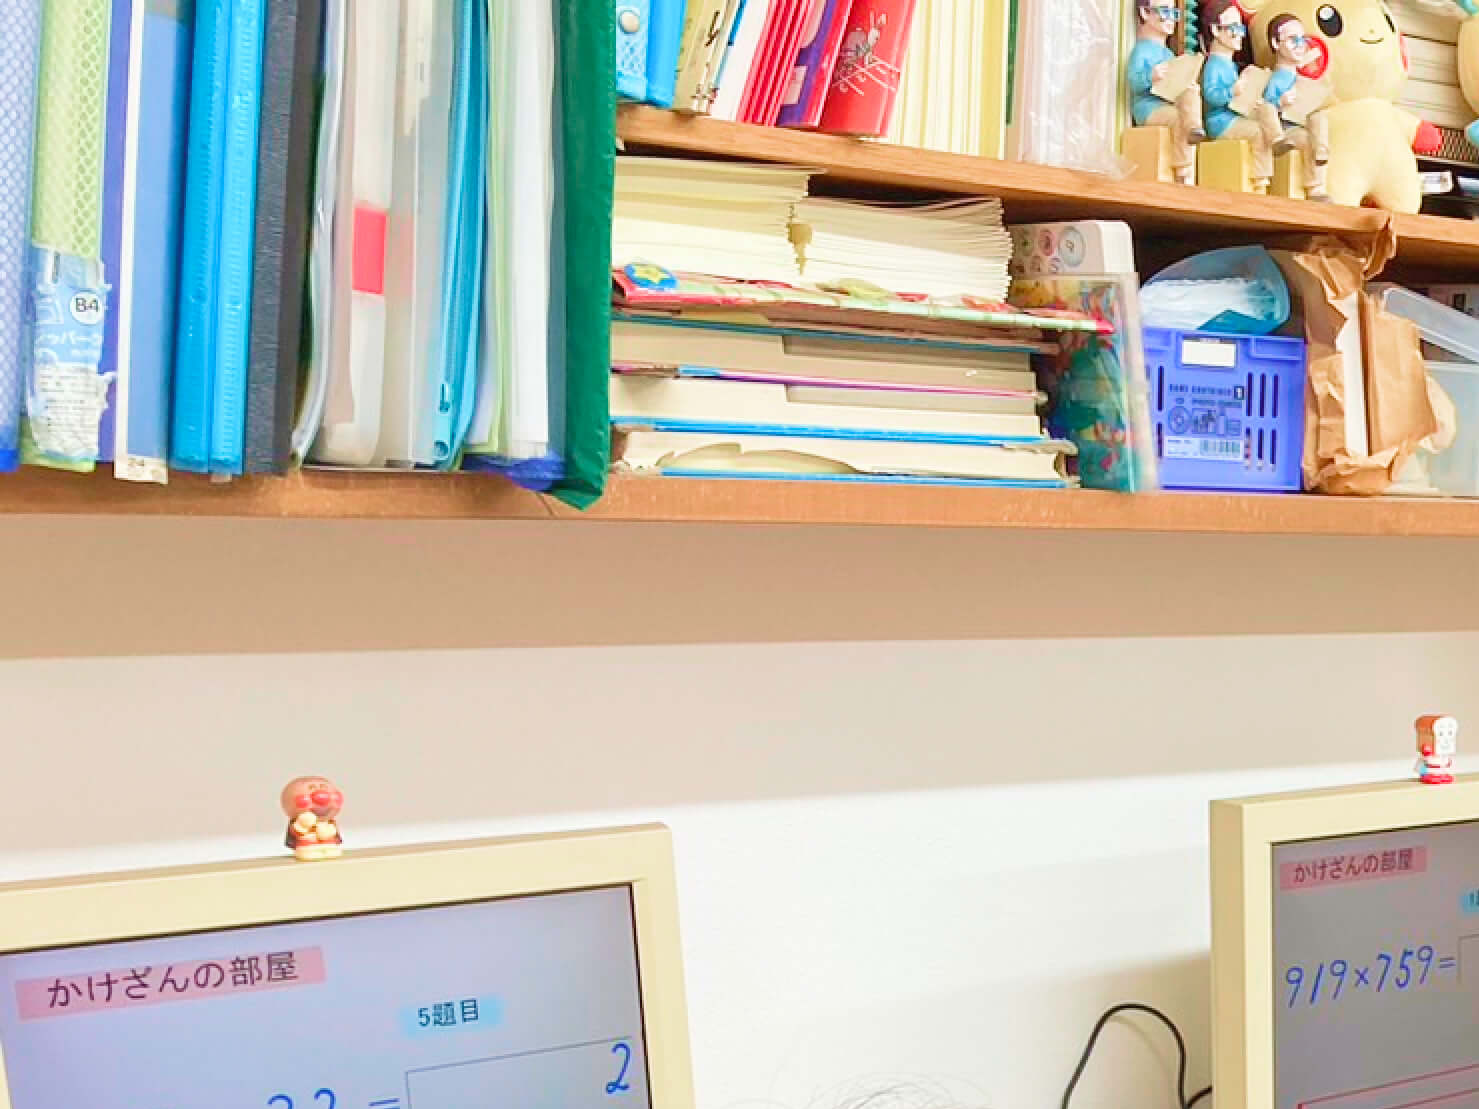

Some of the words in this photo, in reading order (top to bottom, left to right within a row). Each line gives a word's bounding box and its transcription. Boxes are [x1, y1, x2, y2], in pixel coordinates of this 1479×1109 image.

[74, 296, 100, 314] B4
[1293, 848, 1413, 883] かけざんの部屋
[47, 950, 300, 1009] かけざんの部屋
[417, 998, 480, 1027] 5題目
[604, 1042, 633, 1095] 2
